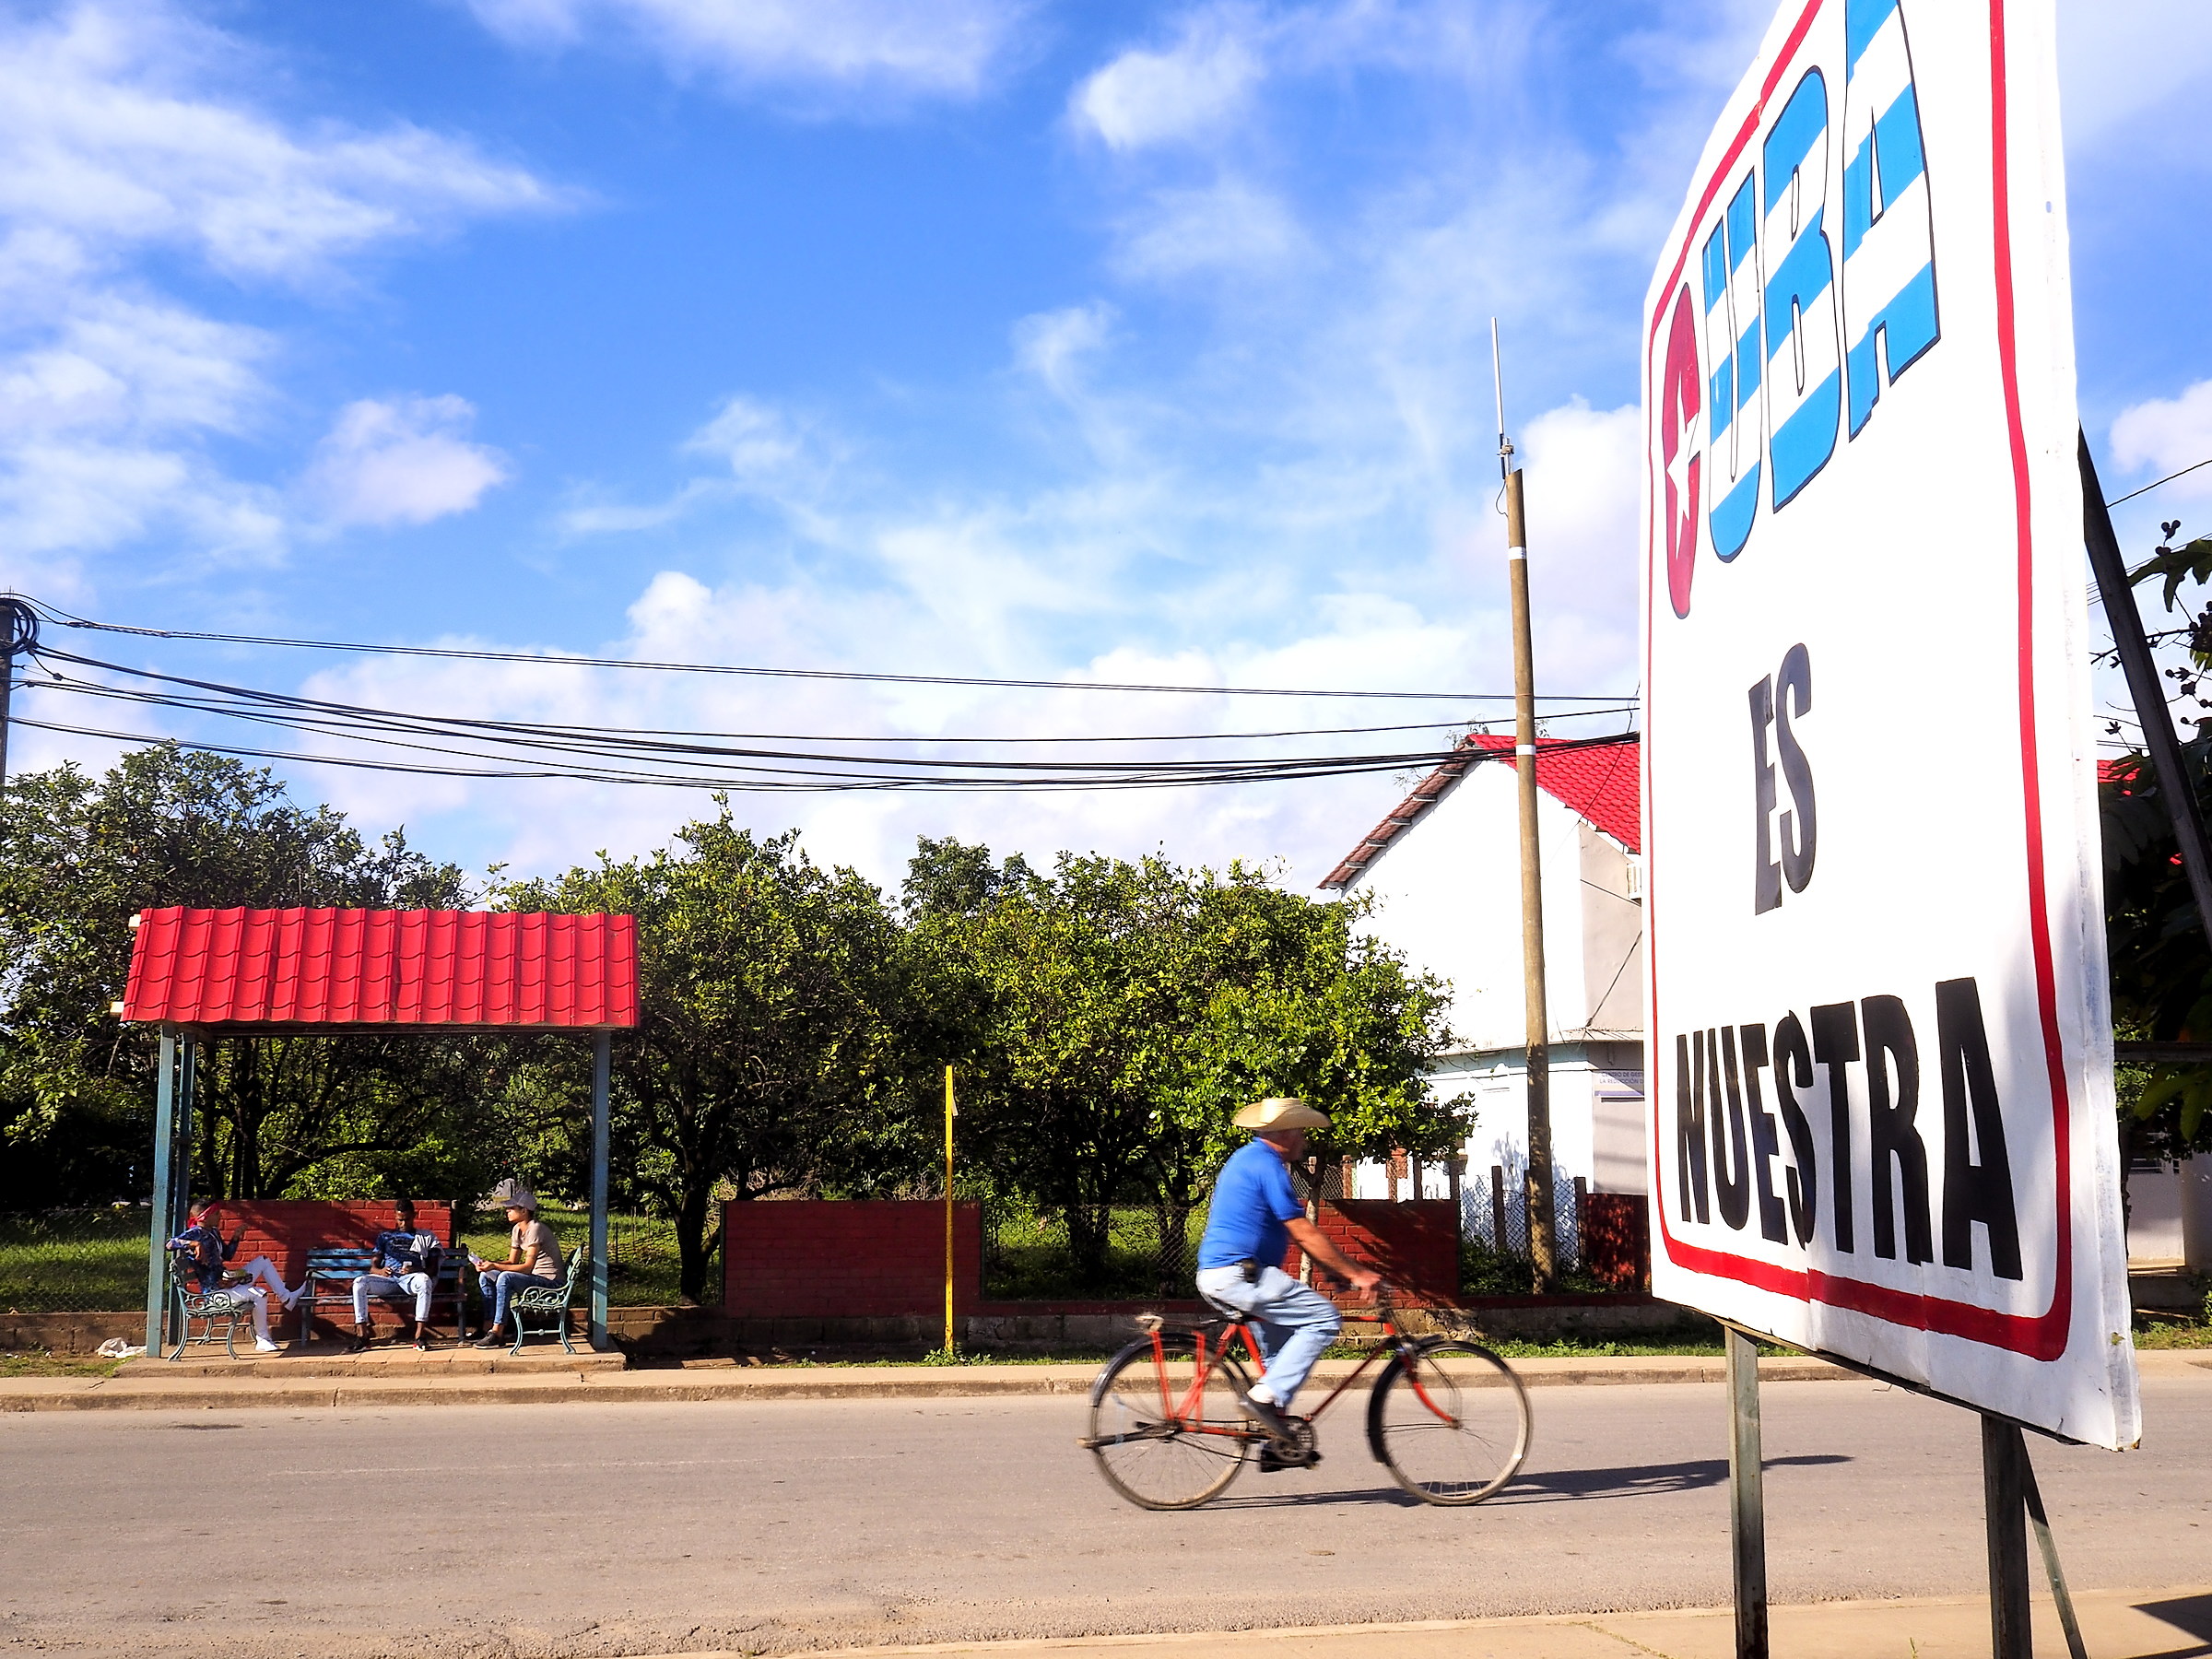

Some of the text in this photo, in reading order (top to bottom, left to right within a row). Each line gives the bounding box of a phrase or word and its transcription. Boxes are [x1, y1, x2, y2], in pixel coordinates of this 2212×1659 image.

[1662, 0, 1941, 619] CUBA
[1748, 642, 1817, 915] ES
[1677, 977, 2023, 1280] NUESTRA
